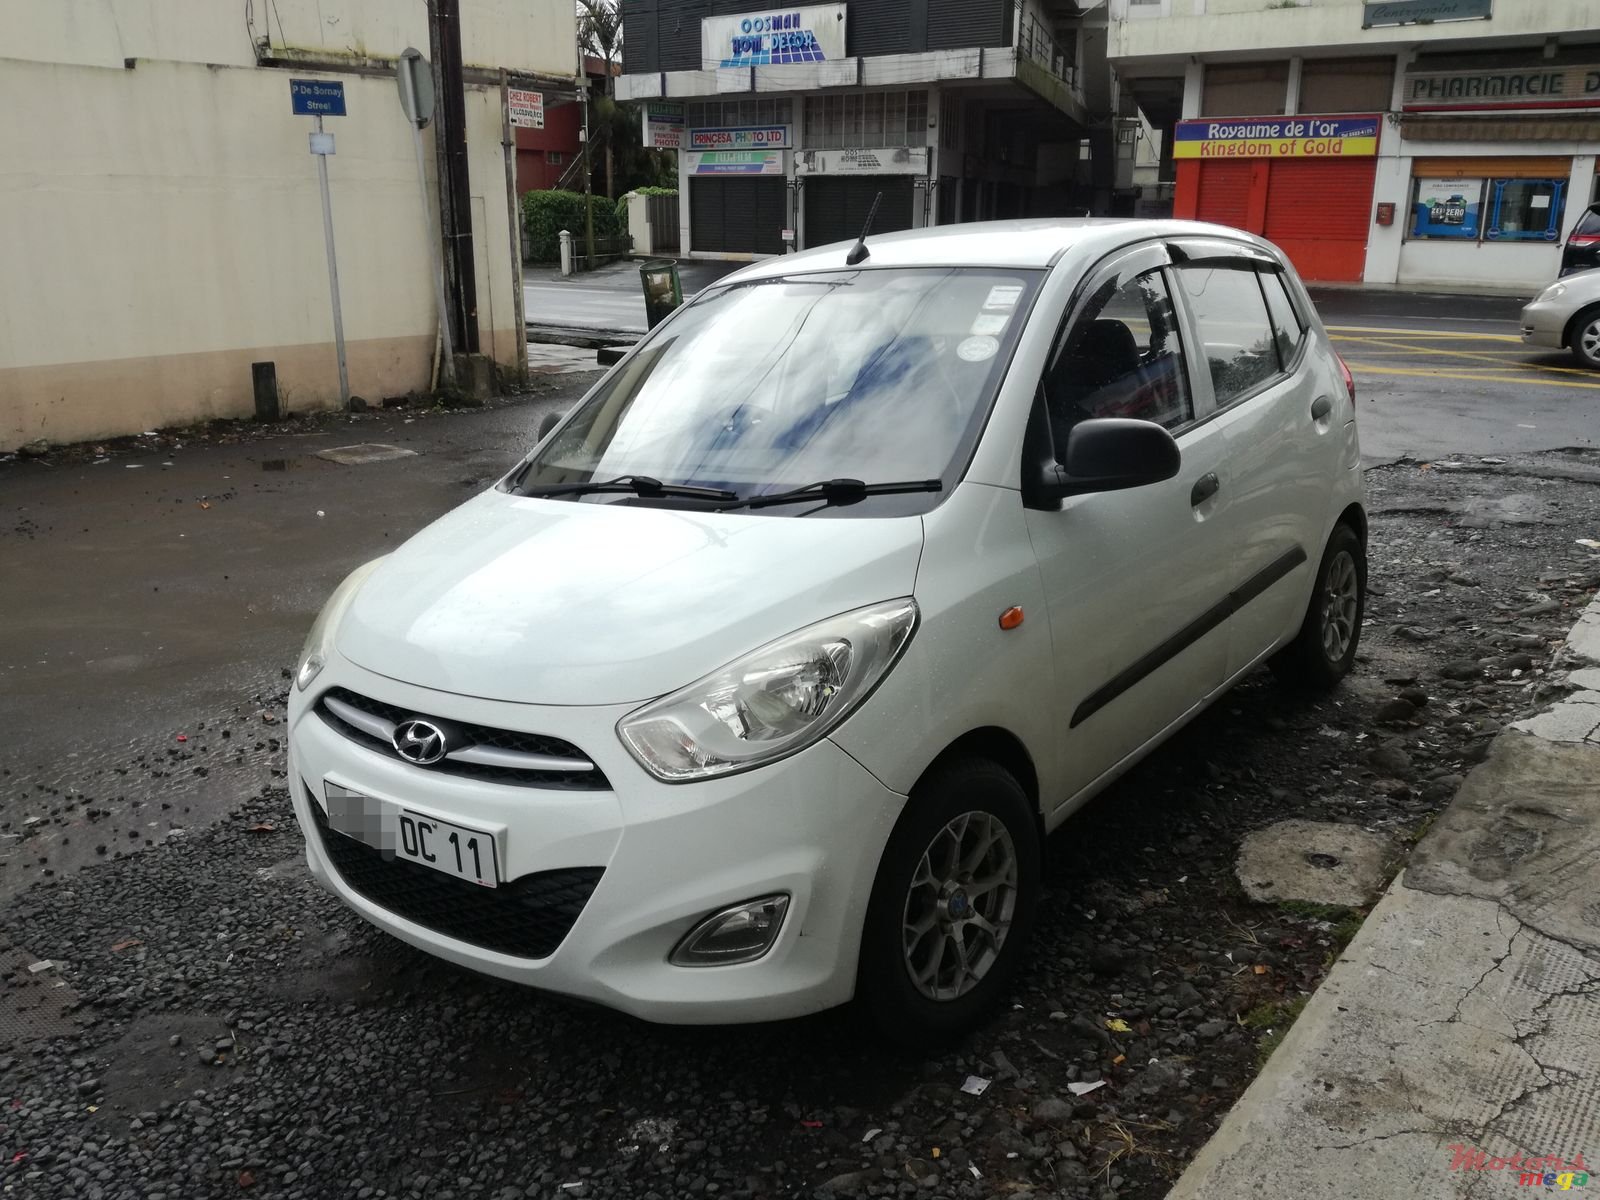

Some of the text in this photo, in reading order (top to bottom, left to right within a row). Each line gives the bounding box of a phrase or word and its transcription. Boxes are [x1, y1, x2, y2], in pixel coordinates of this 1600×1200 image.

[741, 13, 801, 33] OOSMAN
[771, 30, 814, 49] DECOR
[292, 85, 342, 98] P De Sornay
[1413, 73, 1564, 98] PHARMACIE
[510, 91, 542, 105] CHEZ ROBERT
[695, 130, 782, 144] PRINCESA PHOTO LTD
[1208, 122, 1280, 139] Royaume
[1284, 121, 1304, 137] de
[1309, 120, 1339, 136] l'or
[655, 139, 680, 147] PHOTO
[1200, 139, 1343, 156] Kingdom of Gold
[1446, 208, 1464, 216] ZERO
[448, 831, 482, 879] 11
